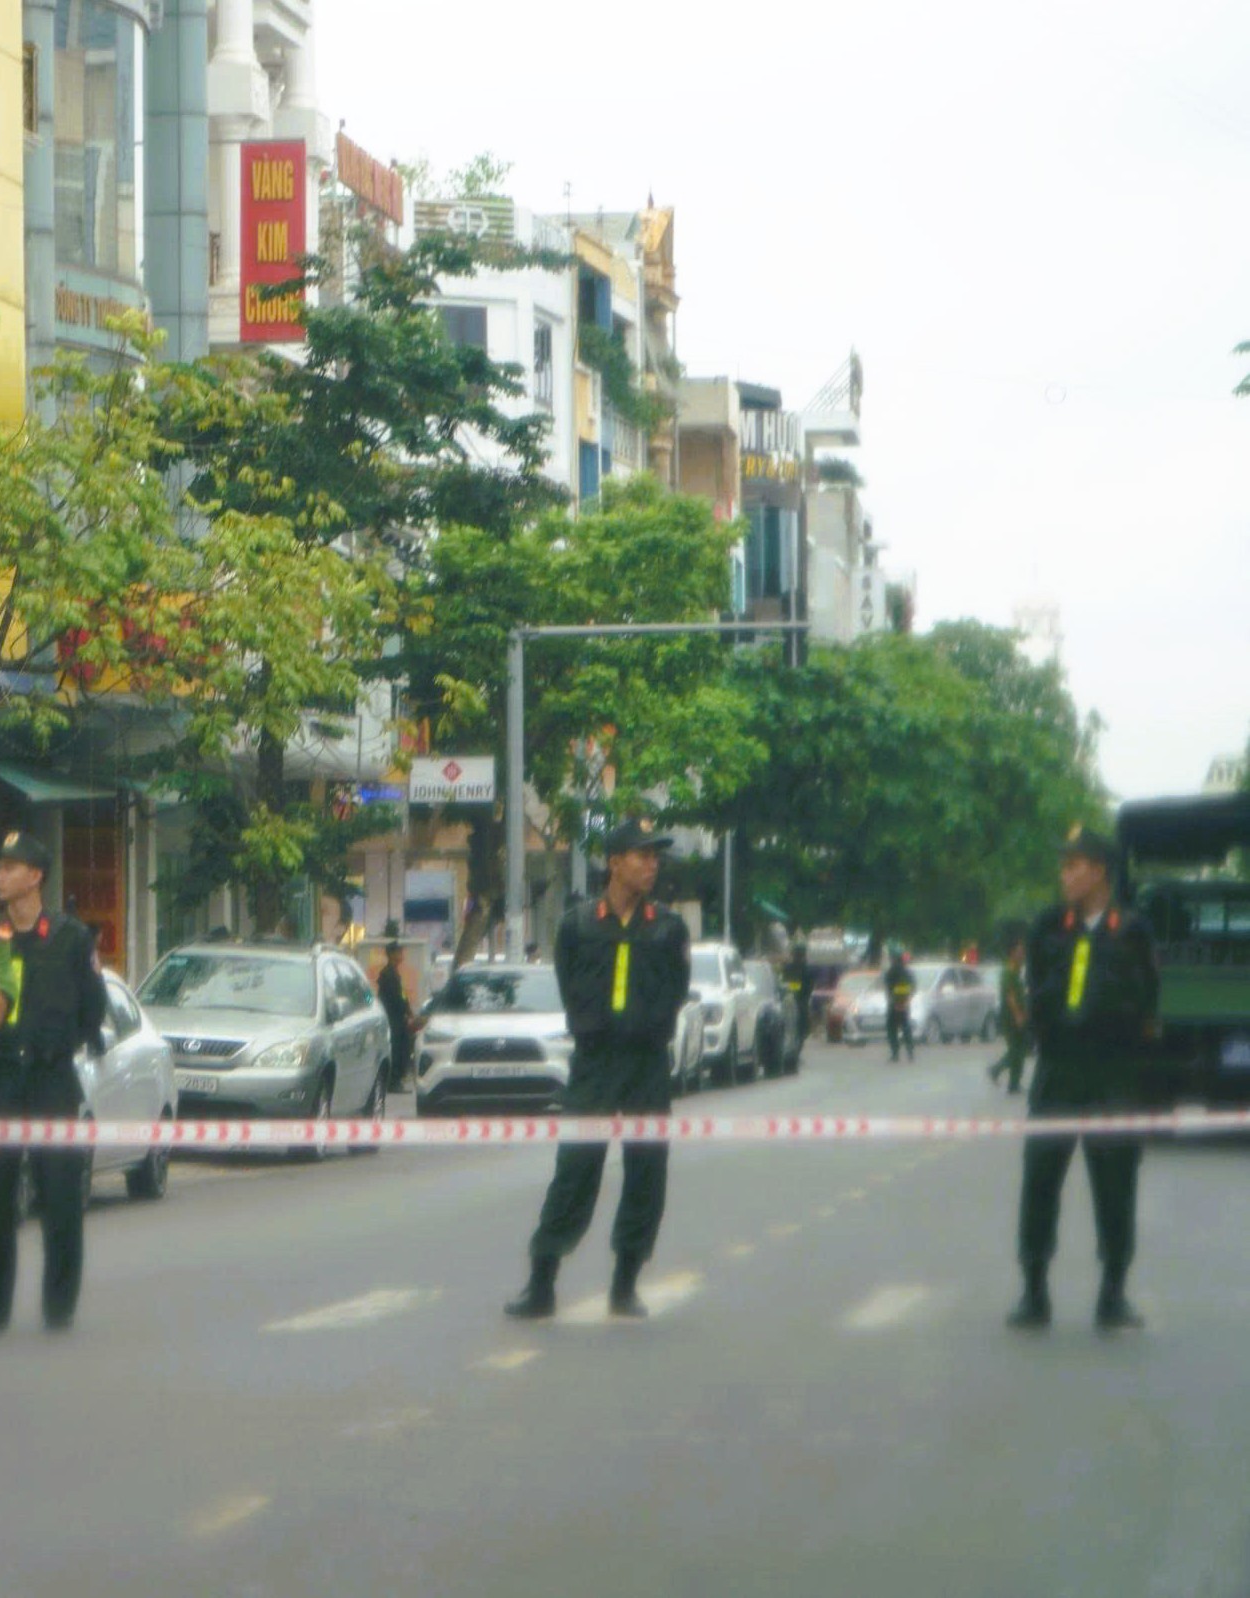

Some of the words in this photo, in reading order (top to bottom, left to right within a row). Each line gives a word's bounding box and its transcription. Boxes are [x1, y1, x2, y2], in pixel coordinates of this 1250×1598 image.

[252, 154, 294, 201] VÀNG
[257, 222, 289, 262] KIM
[414, 785, 447, 799] JOHN
